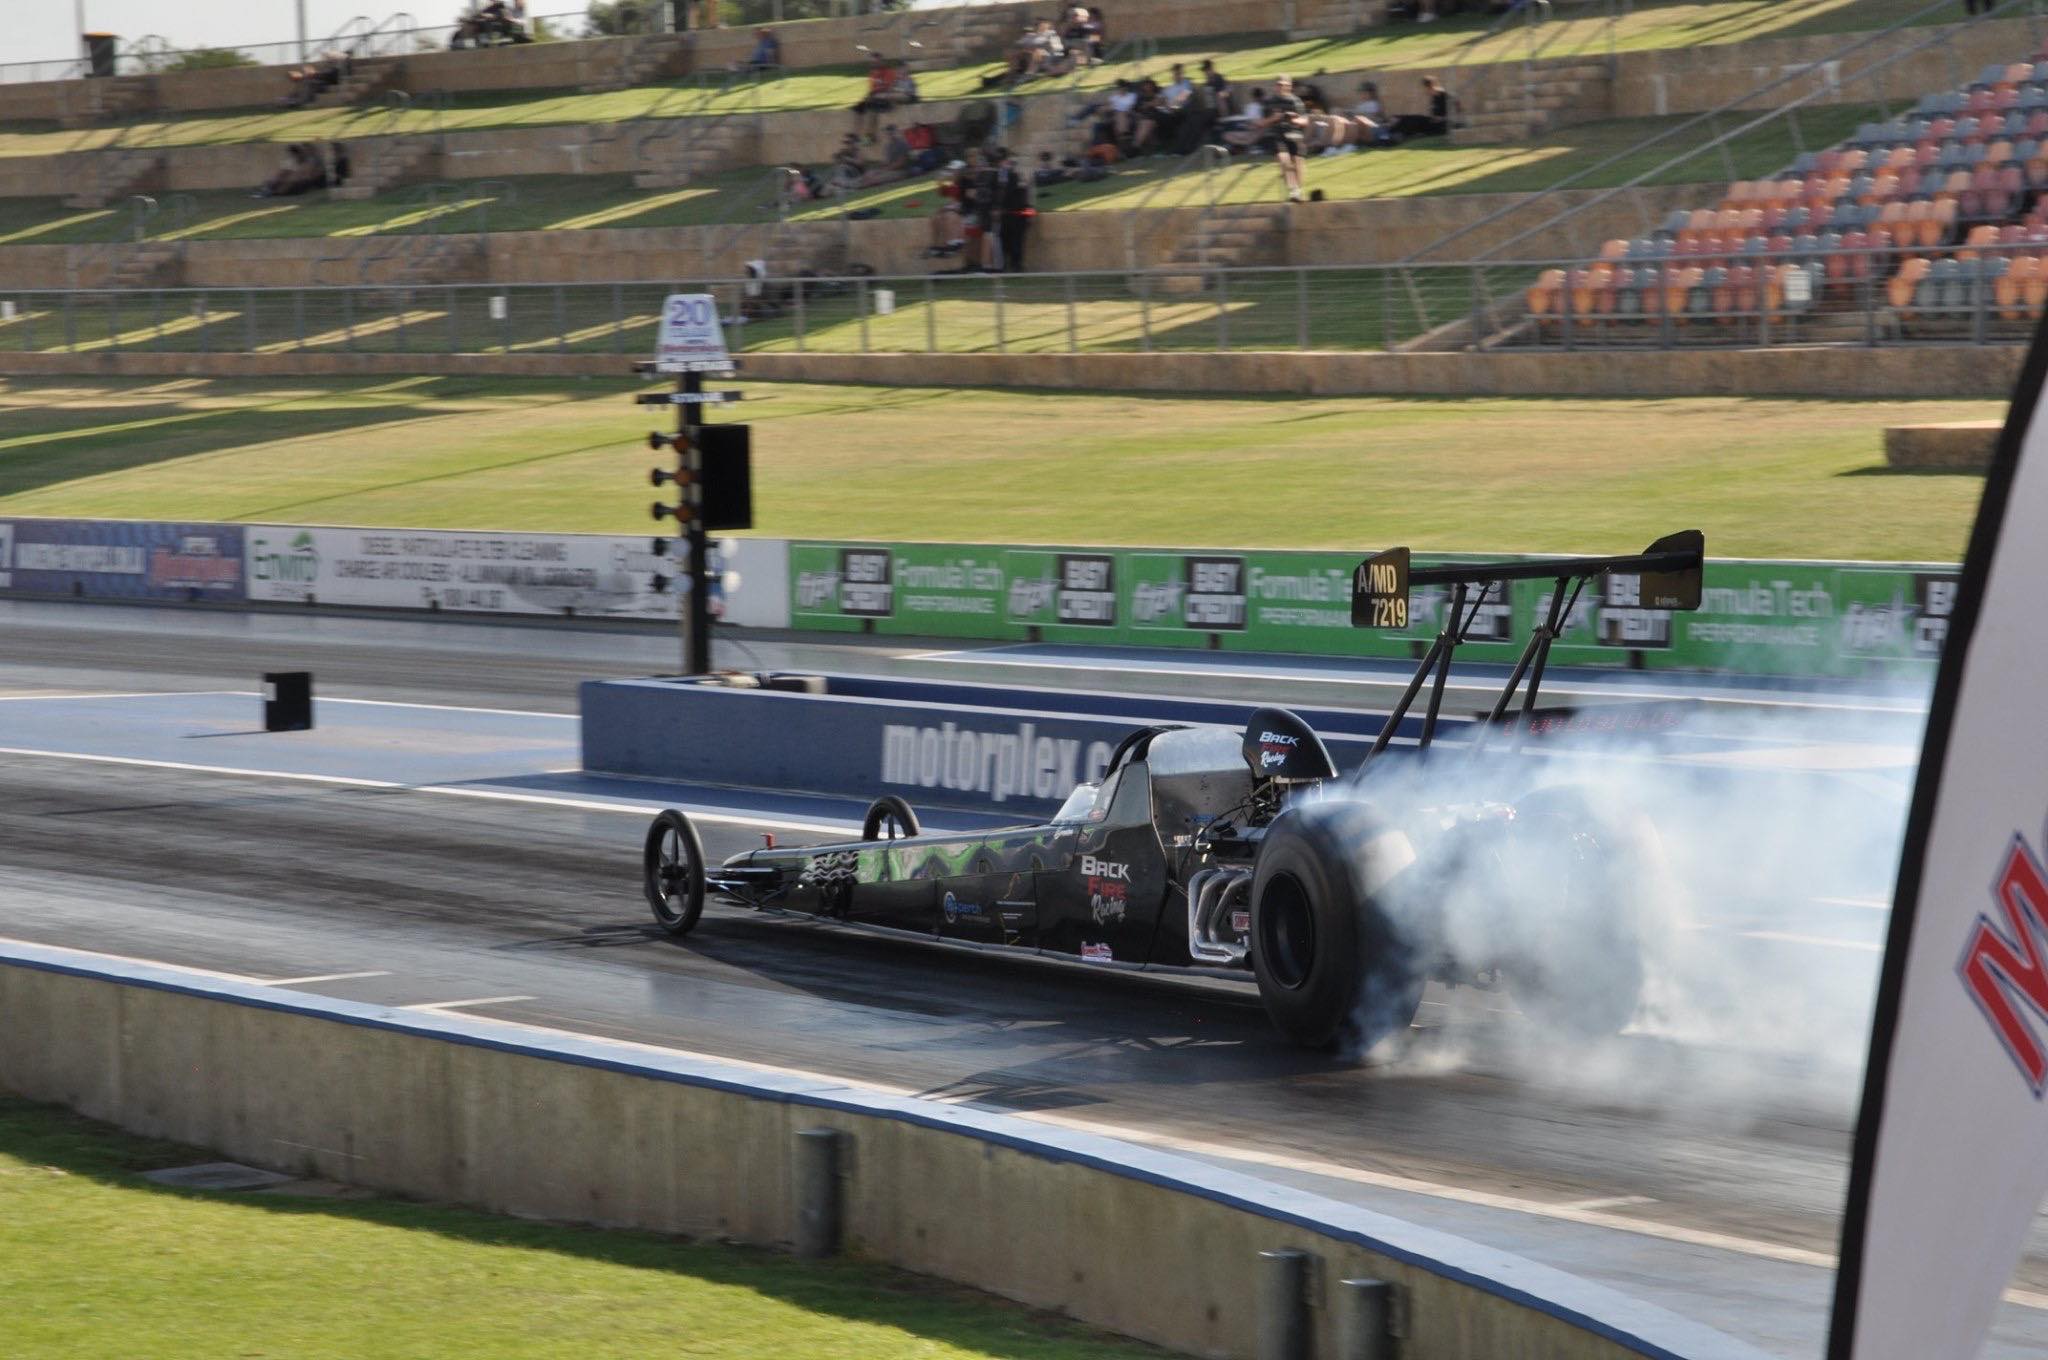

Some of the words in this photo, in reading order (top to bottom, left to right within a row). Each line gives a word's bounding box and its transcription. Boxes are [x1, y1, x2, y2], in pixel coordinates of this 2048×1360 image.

[670, 300, 712, 326] 20
[894, 558, 1004, 590] FormulaTech
[1246, 567, 1353, 601] FormulaTe
[1370, 598, 1407, 628] 7219
